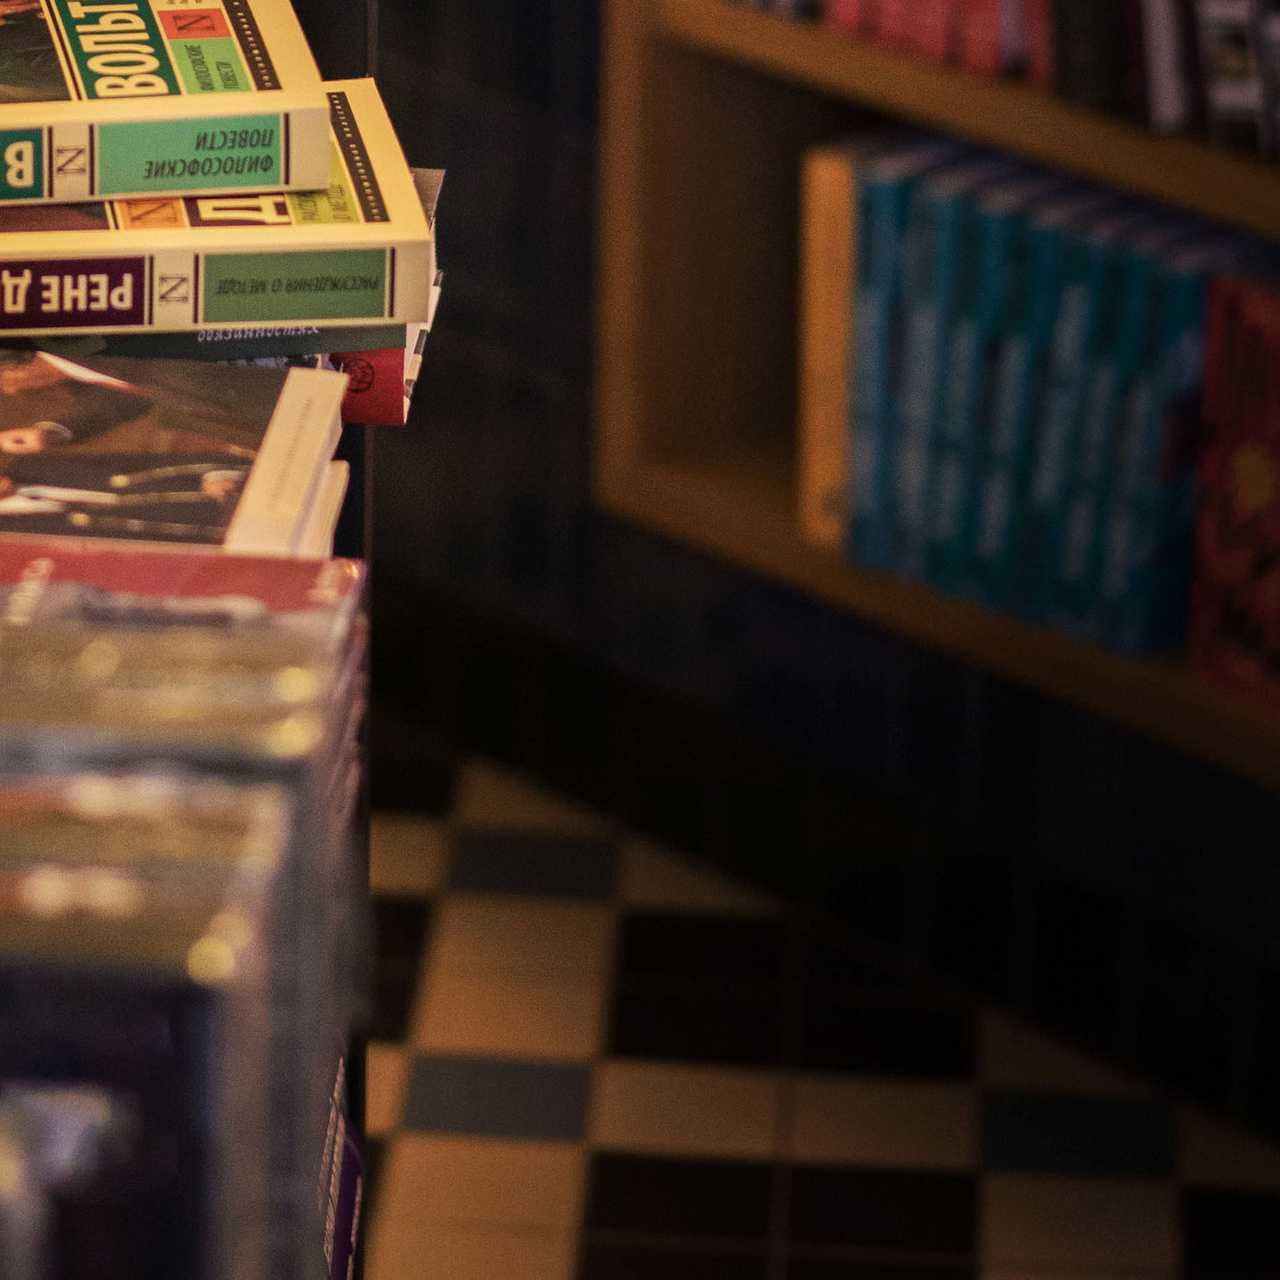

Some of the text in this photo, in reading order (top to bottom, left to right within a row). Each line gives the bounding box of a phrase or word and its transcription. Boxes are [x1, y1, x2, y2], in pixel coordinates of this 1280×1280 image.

[195, 128, 274, 151] ПОВЕСТИ
[144, 154, 274, 180] ФИЛОСОФСКИЕ
[41, 272, 133, 313] РЕНЕ
